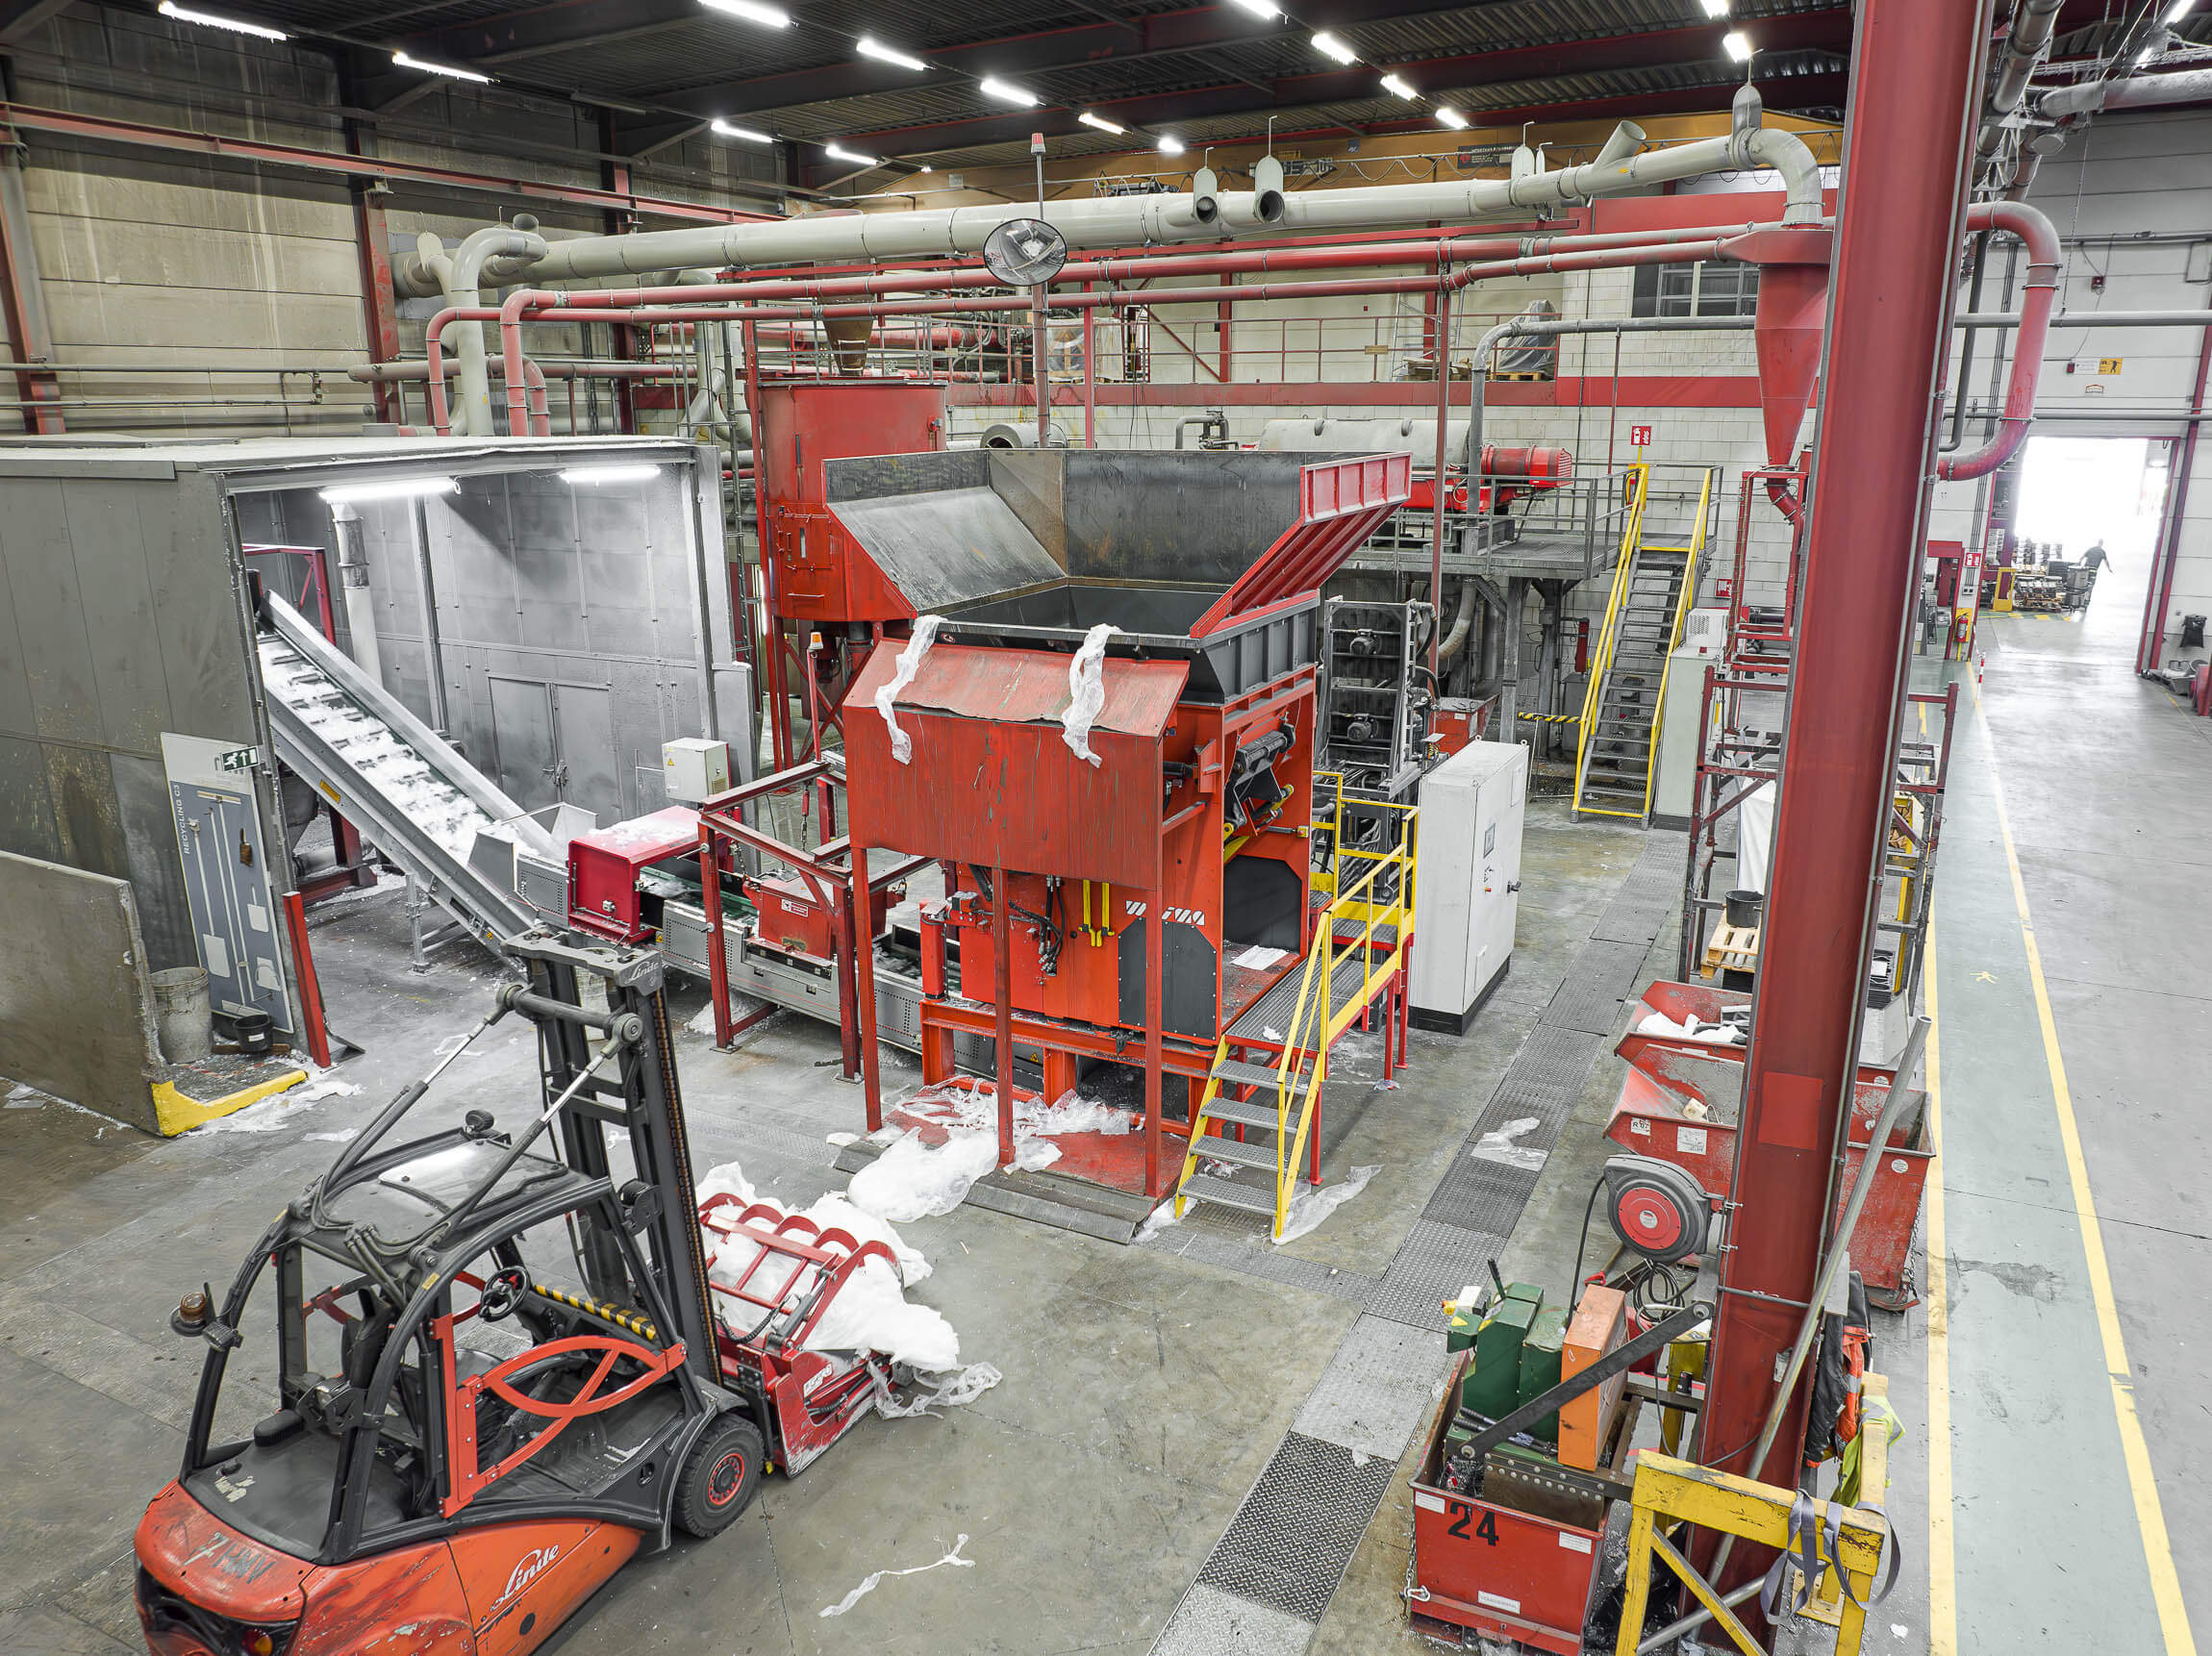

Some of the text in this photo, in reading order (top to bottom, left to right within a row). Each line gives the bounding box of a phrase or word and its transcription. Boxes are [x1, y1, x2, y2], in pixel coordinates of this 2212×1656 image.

[173, 784, 190, 855] RECYCLING C3
[624, 962, 659, 985] Linde
[1447, 1501, 1499, 1546] 24
[490, 1544, 560, 1613] Linde
